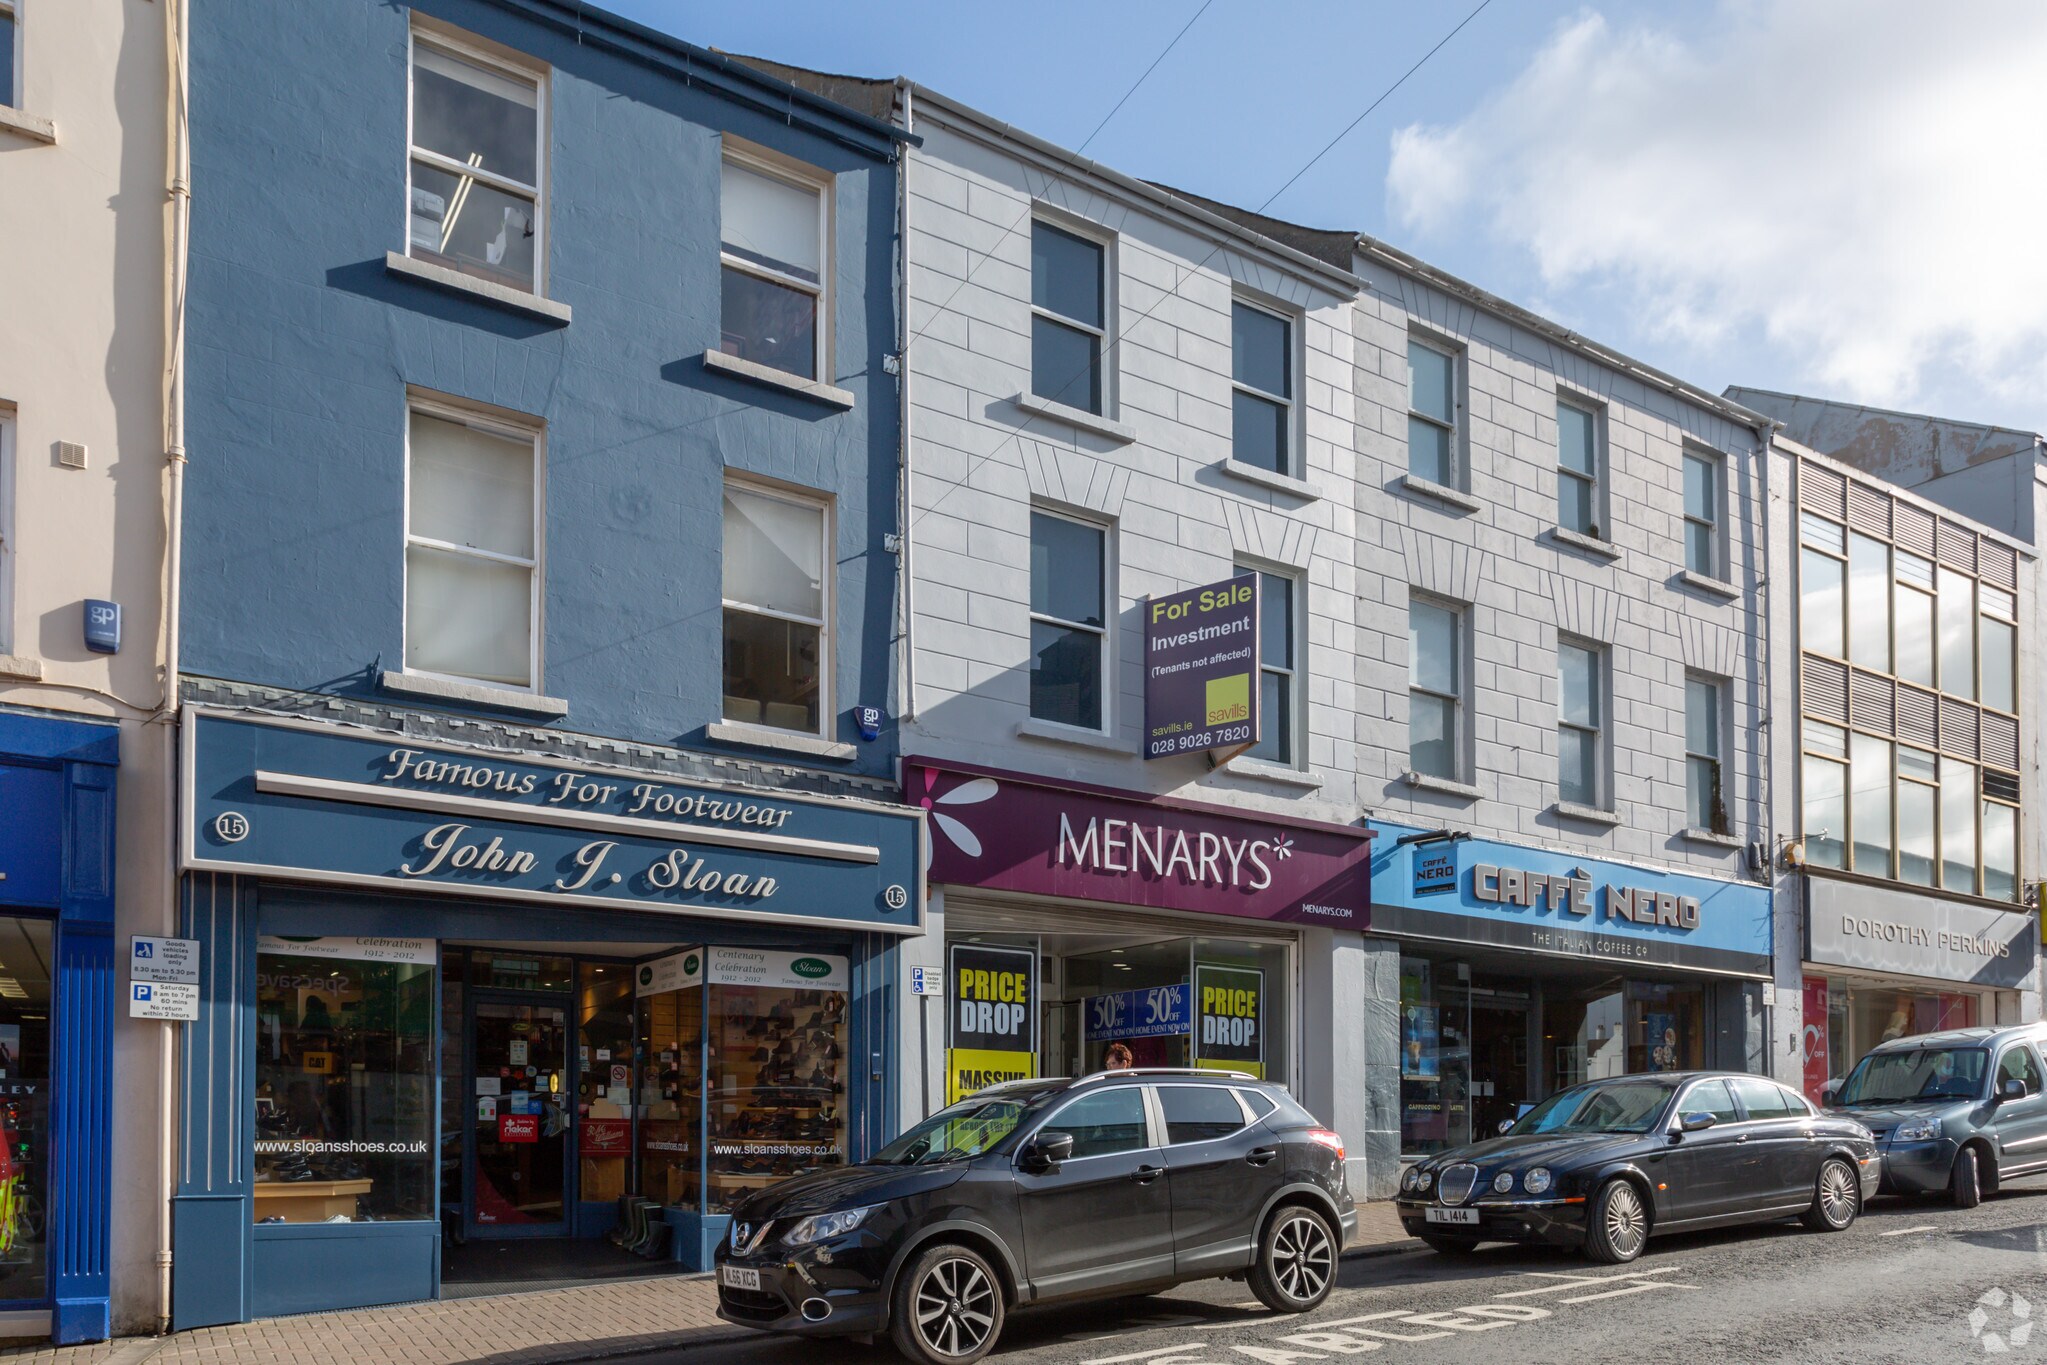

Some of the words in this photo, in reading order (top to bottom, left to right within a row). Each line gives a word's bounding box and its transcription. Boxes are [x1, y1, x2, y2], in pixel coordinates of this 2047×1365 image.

[1152, 600, 1192, 624] For
[1199, 584, 1252, 612] Sale
[1152, 616, 1250, 651] Investment
[1151, 659, 1191, 678] (Tenants
[1192, 655, 1208, 668] not
[1210, 647, 1251, 666] affected)
[1209, 703, 1247, 723] savills
[1152, 721, 1193, 737] savills.ie
[1151, 739, 1175, 754] 028
[1179, 732, 1212, 750] 9026
[1216, 725, 1250, 743] 7820
[383, 749, 538, 794] Famous
[550, 773, 617, 804] For
[628, 784, 792, 828] Footwear
[220, 817, 245, 835] 15
[1058, 812, 1272, 889] MENARYS
[401, 823, 540, 876] John
[555, 840, 622, 890] J.
[648, 849, 780, 898] Sloan
[1416, 864, 1454, 882] NERO
[888, 890, 905, 904] 15
[1473, 864, 1593, 916] CAFFÈ
[1606, 883, 1701, 929] NERO
[1302, 903, 1353, 918] MENARYS.COM
[356, 936, 423, 950] Celebration
[1532, 932, 1551, 945] THE
[1554, 935, 1593, 951] ITALIAN
[1596, 941, 1632, 955] COFFEE
[1842, 913, 1932, 947] DOROTHY
[1938, 930, 2010, 958] PERKINS
[364, 949, 385, 957] 1912
[393, 951, 416, 960] 2012
[716, 949, 766, 963] Centenary
[714, 961, 767, 974] Celebration
[721, 974, 738, 982] 1912
[743, 975, 762, 984] 2012
[960, 968, 1026, 1004] PRICE
[160, 984, 190, 992] Saturday
[1146, 986, 1182, 1024] 50%
[1203, 986, 1256, 1018] PRICE
[960, 1000, 1025, 1035] DROP
[1094, 993, 1125, 1029] 50%
[1169, 1011, 1182, 1022] OFF
[1114, 1018, 1124, 1027] OFF
[1135, 1024, 1152, 1035] HOME
[1151, 1023, 1168, 1033] EVENT
[1167, 1023, 1181, 1033] NOW
[1180, 1022, 1190, 1031] ON
[1098, 1029, 1113, 1039] EVENT
[1112, 1028, 1126, 1037] NOW
[1125, 1027, 1134, 1036] ON
[1203, 1015, 1255, 1047] DROP
[1814, 1050, 1825, 1058] OFF
[308, 1057, 326, 1069] CAT
[1408, 1103, 1441, 1111] CAPPUCCINO
[253, 1139, 427, 1153] www.sloansshoes.co.uk
[714, 1143, 842, 1155] www.sloansshoes.co.uk
[1433, 1209, 1448, 1221] TIL
[1449, 1210, 1468, 1222] 1414
[741, 1271, 757, 1287] XCG
